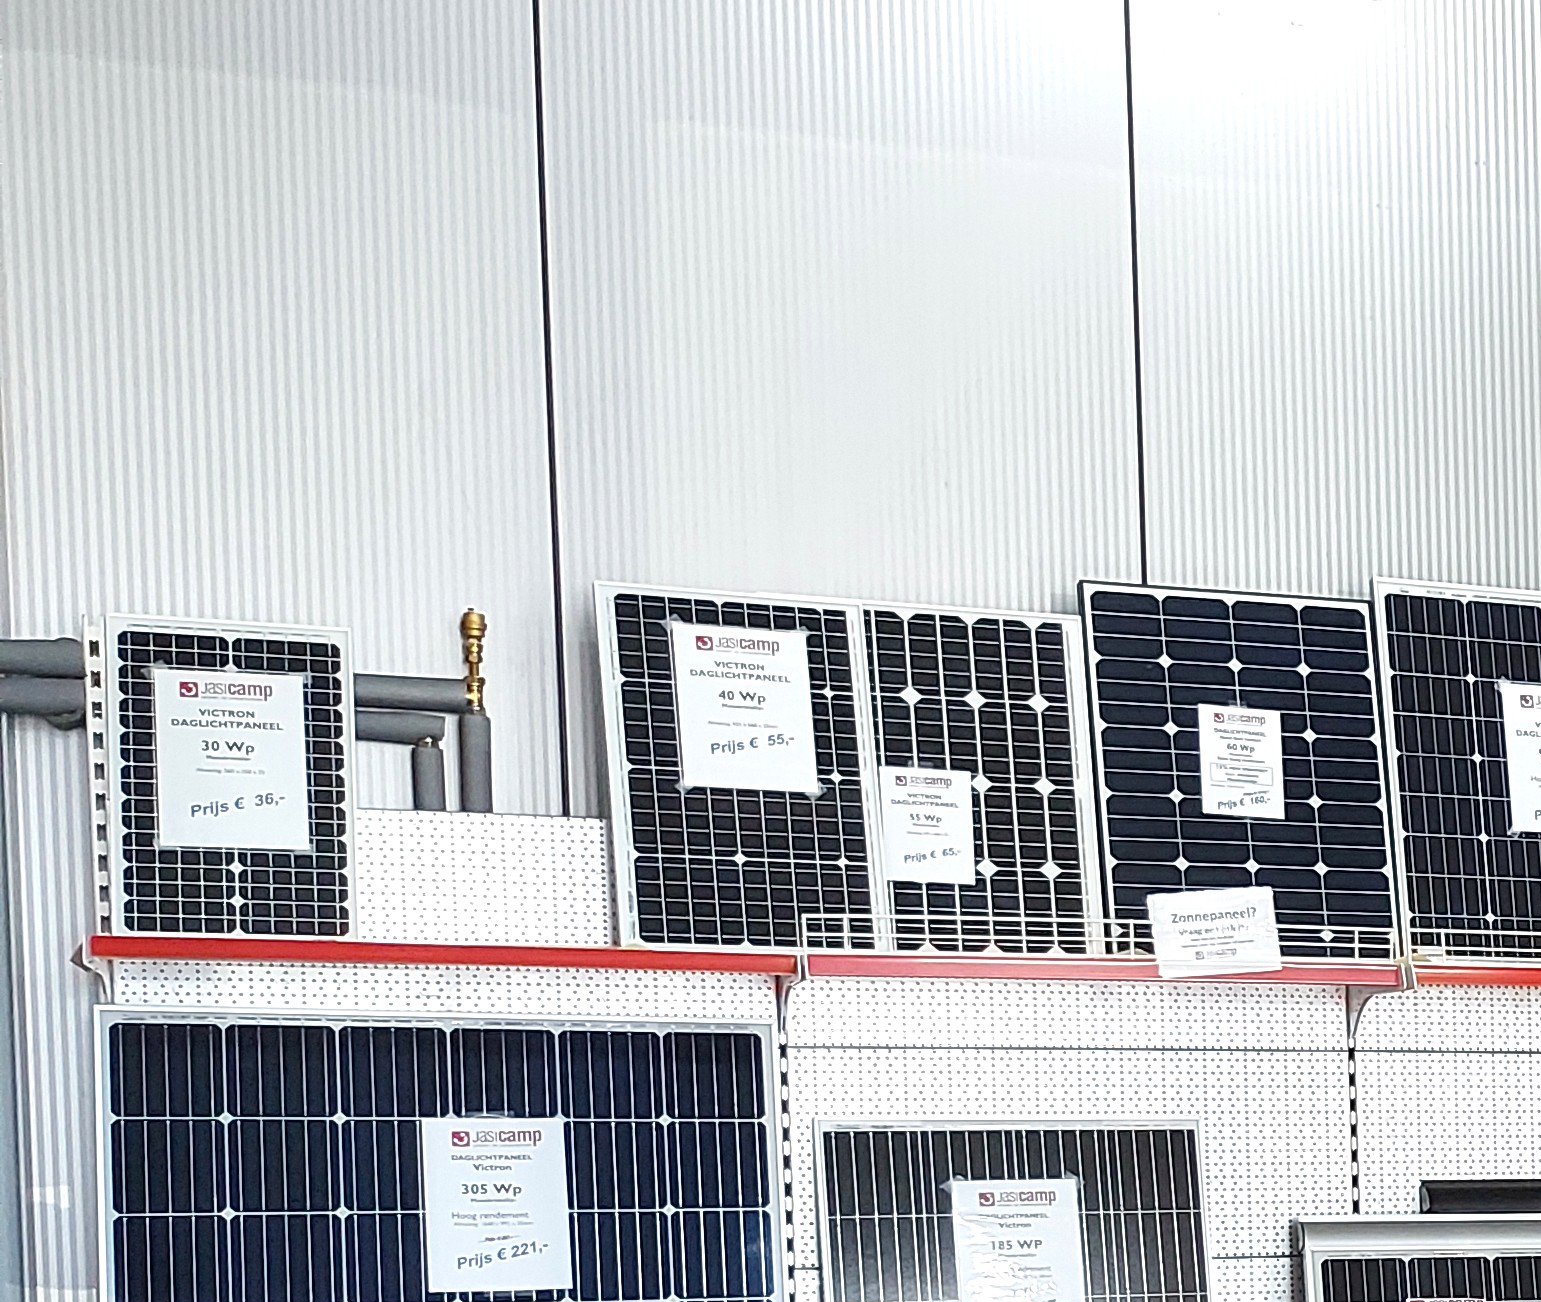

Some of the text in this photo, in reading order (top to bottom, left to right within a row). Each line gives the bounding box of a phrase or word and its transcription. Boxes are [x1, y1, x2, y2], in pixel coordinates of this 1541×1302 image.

[714, 661, 764, 671] VICTRON
[690, 669, 790, 683] DAGLICHTPANEEL
[719, 691, 766, 705] 40 Wp
[199, 709, 255, 718] VICTRON
[171, 719, 283, 730] DAGLICHTPANEEL
[201, 740, 255, 755] 30 Wp
[711, 734, 794, 754] Prijs € 55,-
[1240, 745, 1255, 753] Wp
[191, 793, 285, 817] Prijs € 36,-
[924, 814, 941, 823] Wp
[1171, 907, 1256, 923] Zonnepaneel?
[462, 1184, 522, 1196] 305 Wp
[1017, 1240, 1042, 1249] WP
[457, 1241, 549, 1269] Prijs € 221,-
